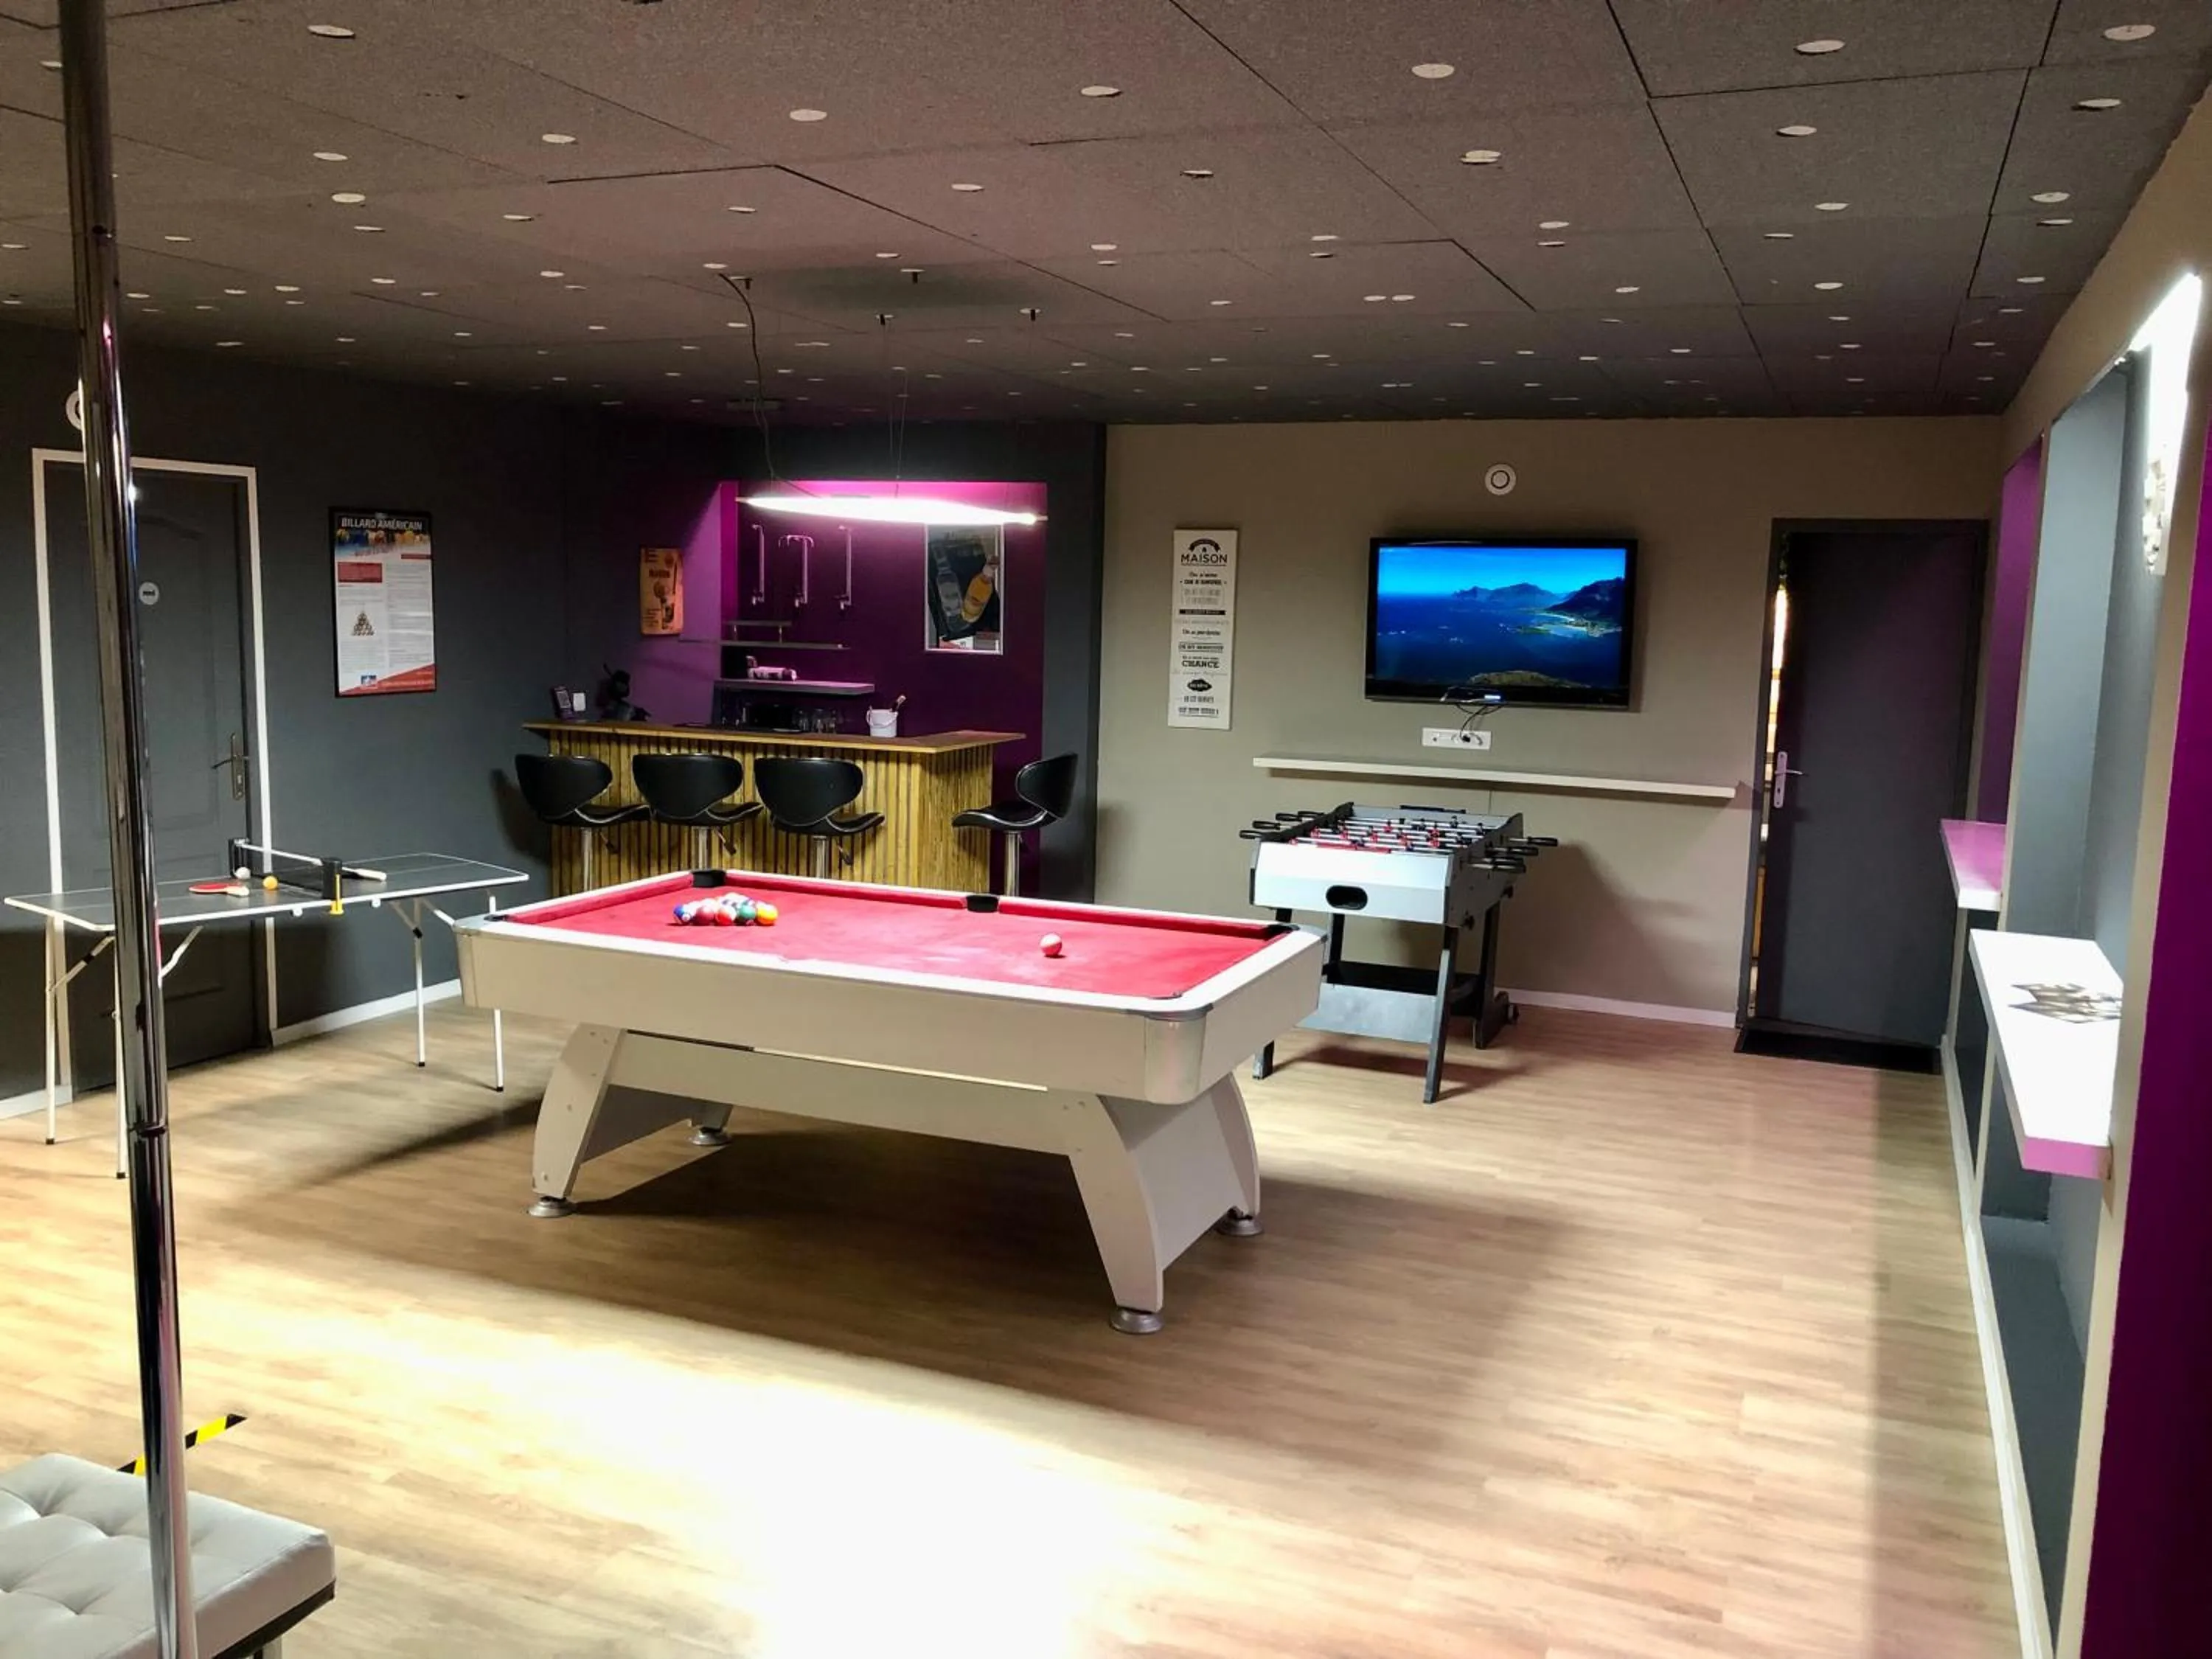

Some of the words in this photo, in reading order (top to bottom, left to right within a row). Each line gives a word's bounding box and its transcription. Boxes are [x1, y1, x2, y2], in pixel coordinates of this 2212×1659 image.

[341, 518, 376, 528] BILLARD
[1180, 554, 1228, 563] MAISON
[1181, 660, 1220, 668] CHANCE
